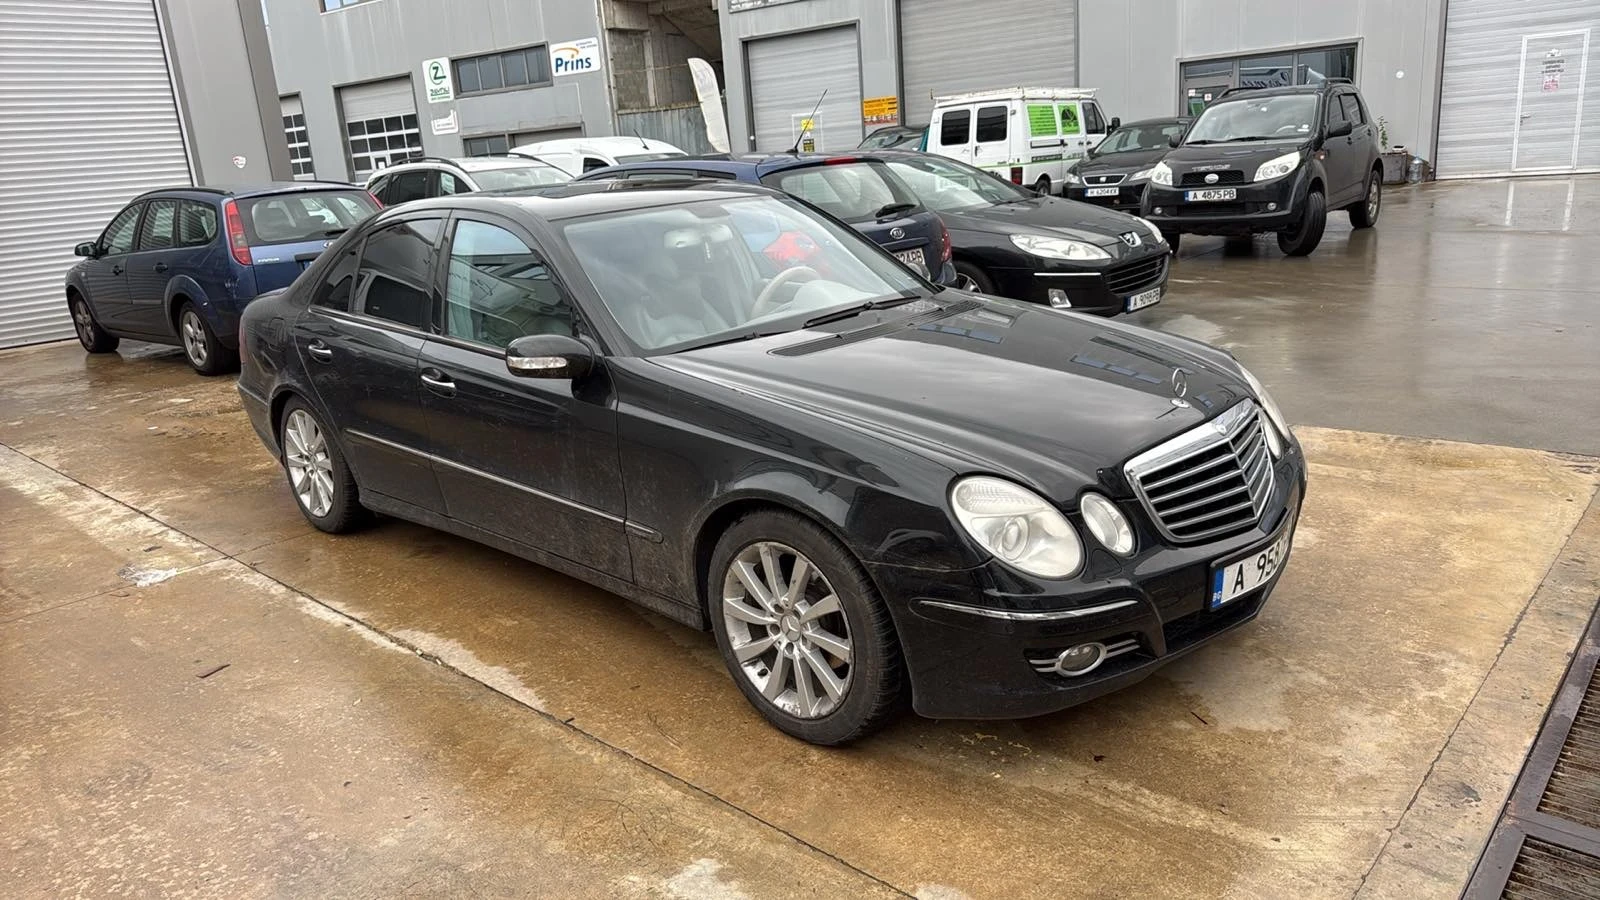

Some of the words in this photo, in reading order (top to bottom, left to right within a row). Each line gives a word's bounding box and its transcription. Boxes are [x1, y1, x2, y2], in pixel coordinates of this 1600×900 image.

[555, 54, 592, 73] Prins
[1193, 192, 1198, 200] A
[1202, 190, 1222, 200] 4875
[1223, 189, 1235, 199] PB
[1232, 563, 1244, 594] A
